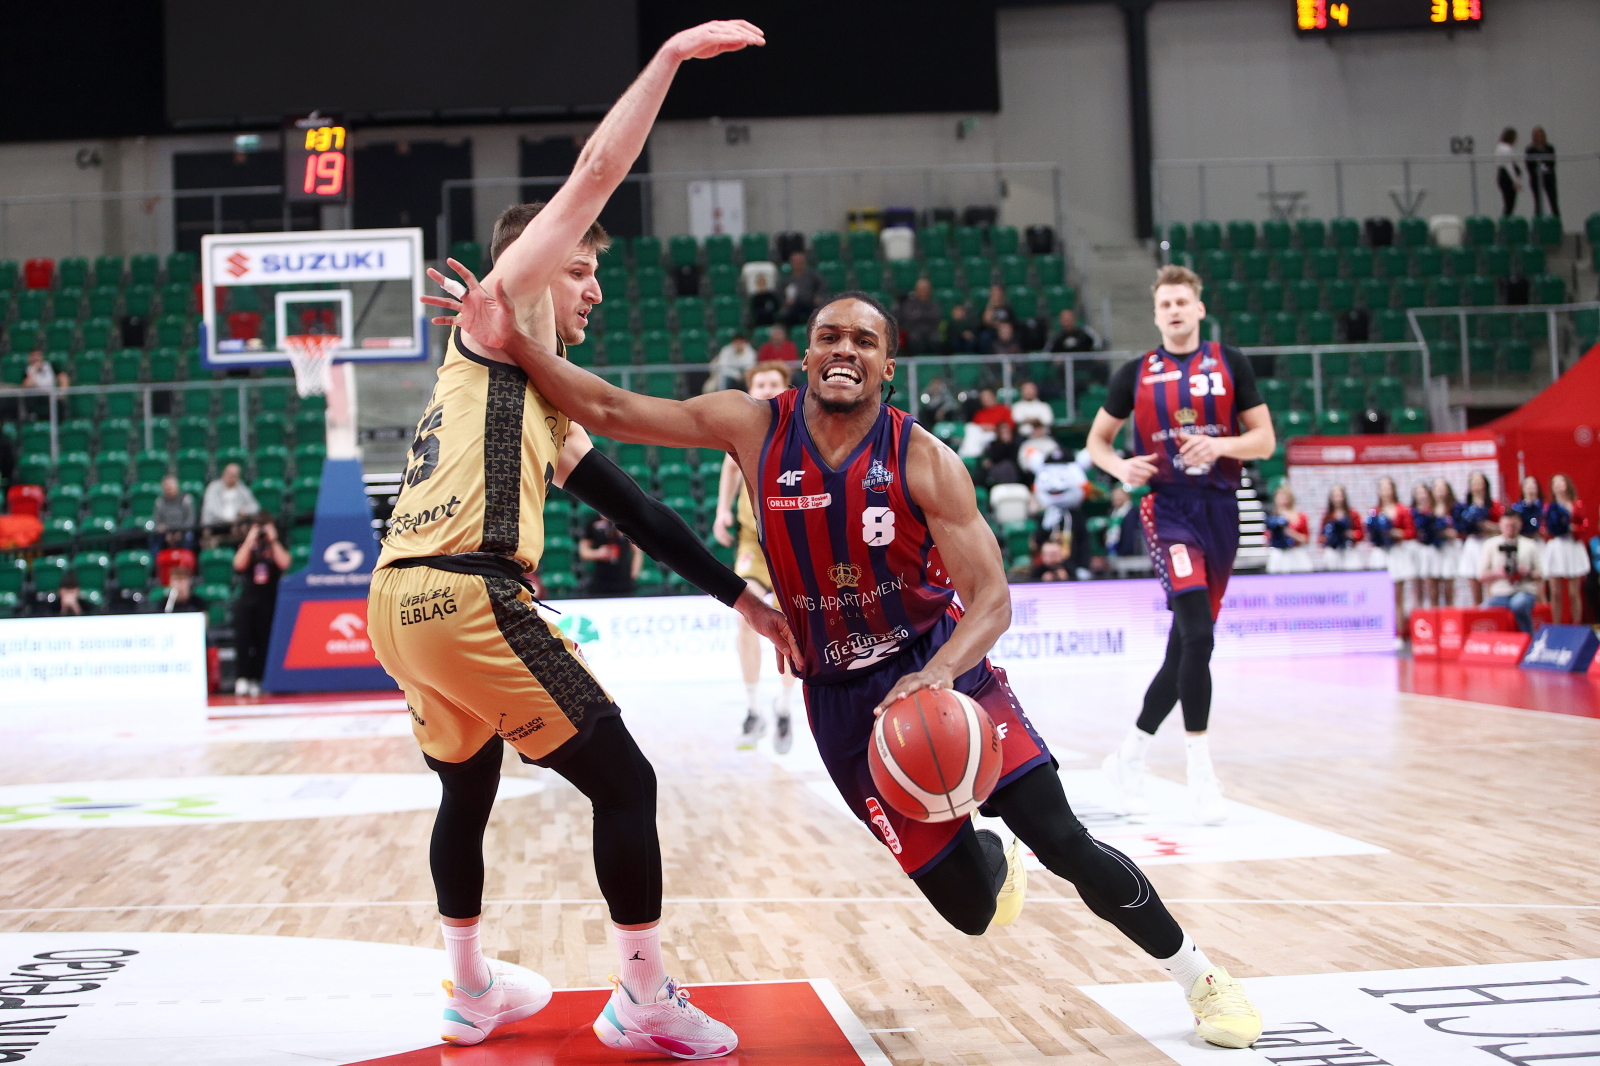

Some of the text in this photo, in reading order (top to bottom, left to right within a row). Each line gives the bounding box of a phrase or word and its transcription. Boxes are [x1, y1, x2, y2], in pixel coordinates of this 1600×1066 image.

[1330, 3, 1349, 27] 4
[303, 152, 345, 195] 19
[261, 251, 386, 273] SUZUKI
[1189, 372, 1227, 397] 31
[776, 470, 806, 486] 4F
[862, 506, 896, 547] 8
[401, 599, 457, 626] ELBLĄG
[792, 592, 816, 611] KING
[829, 607, 877, 626] GALAXY
[526, 716, 543, 730] LECH
